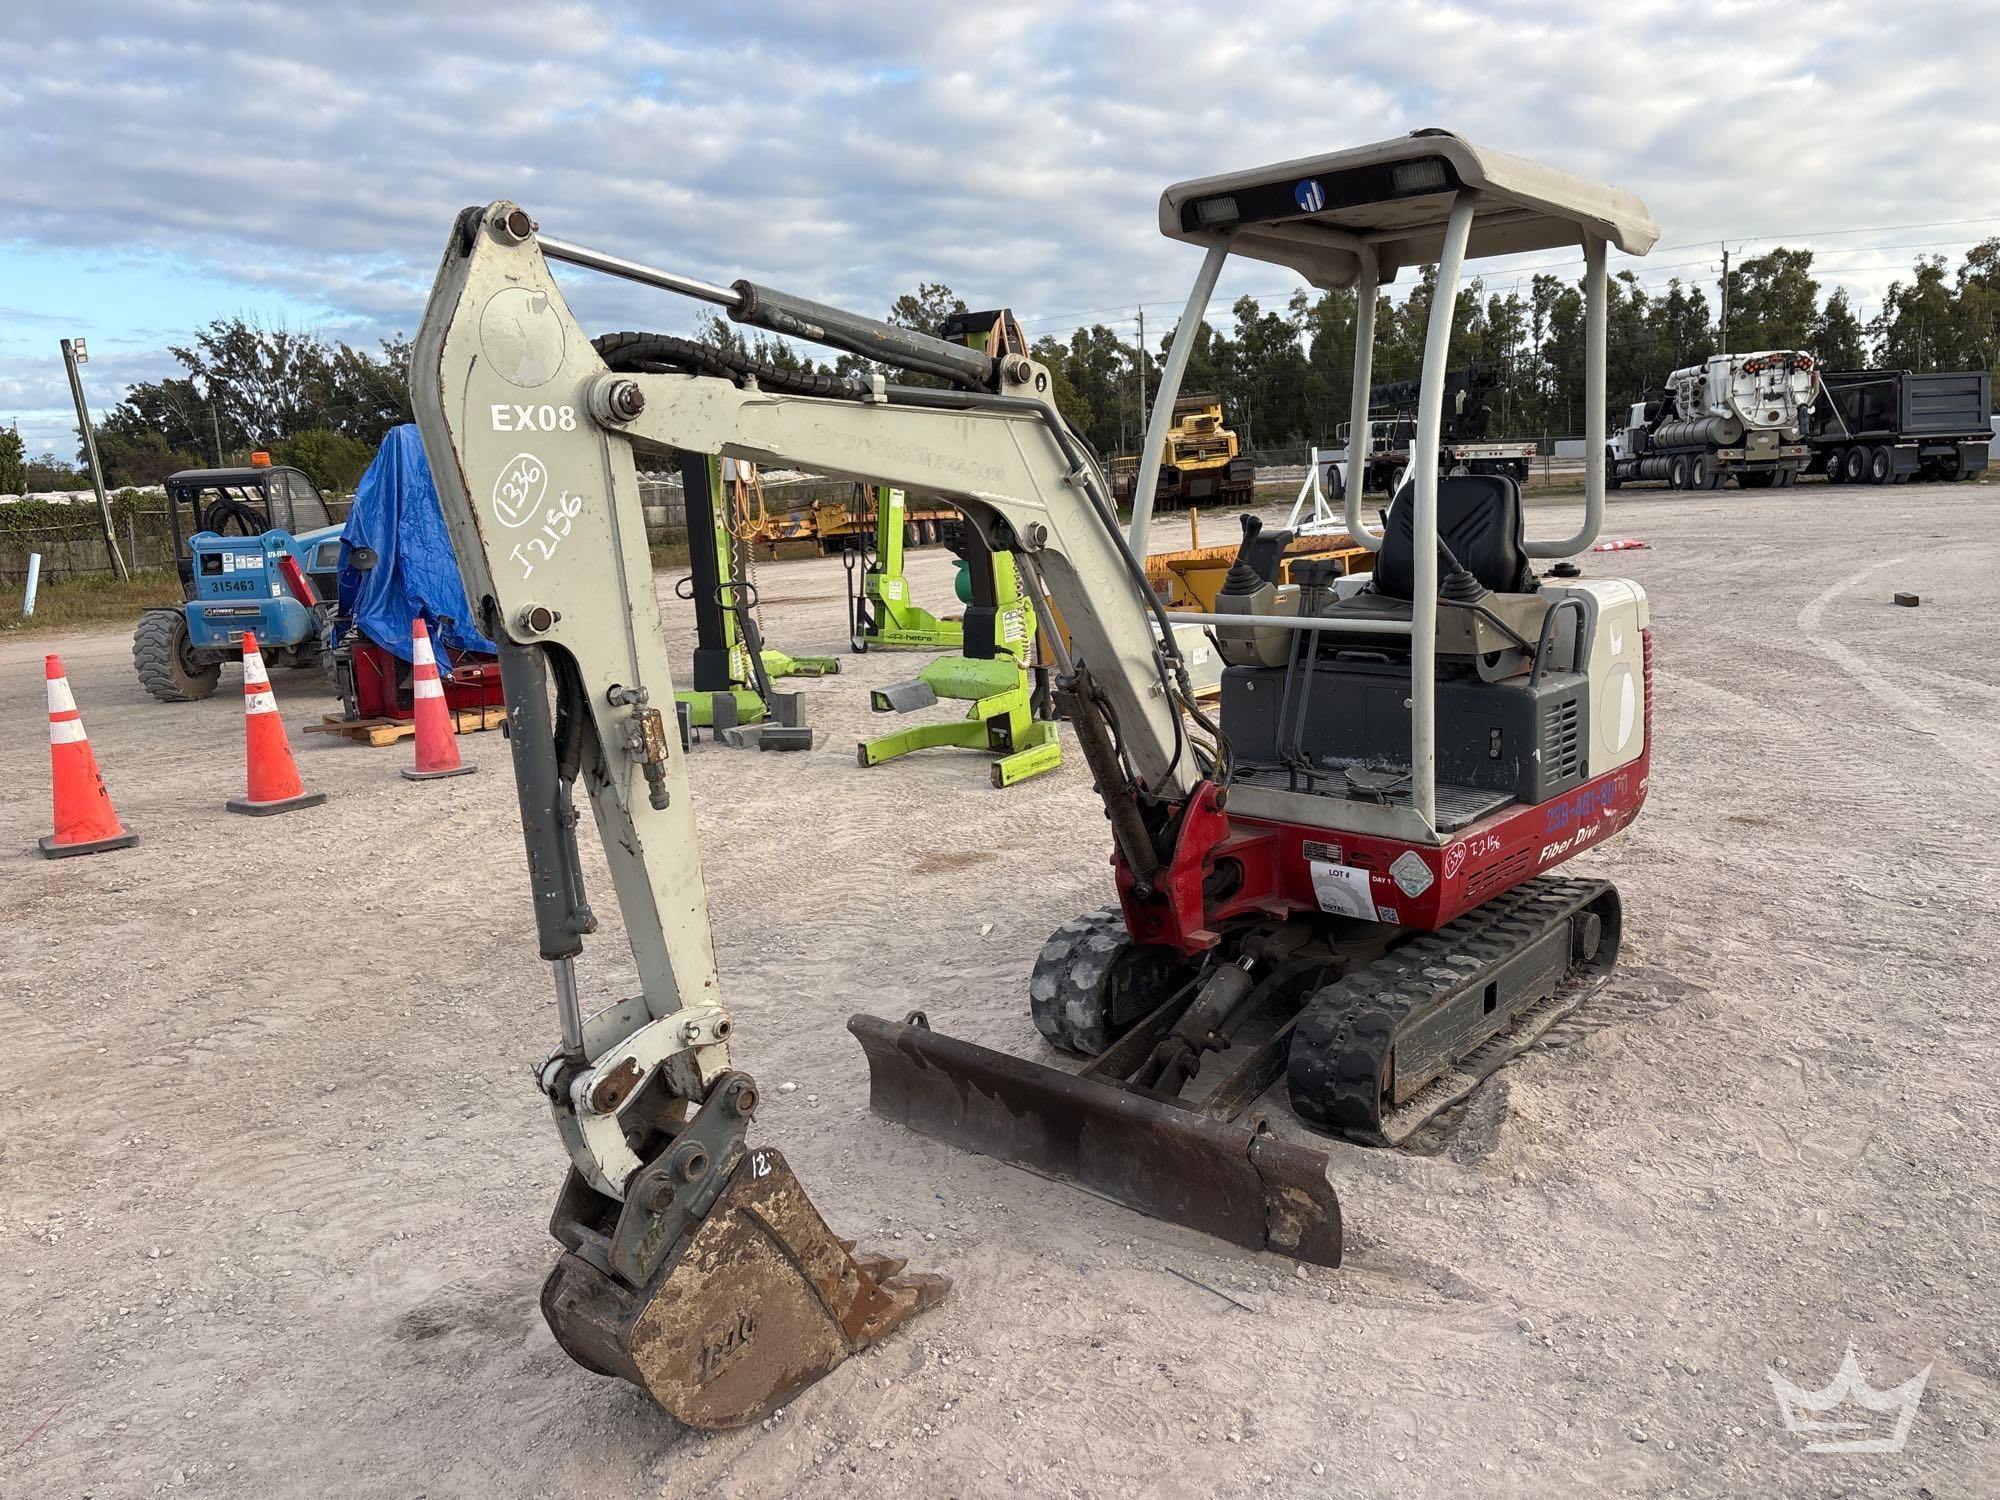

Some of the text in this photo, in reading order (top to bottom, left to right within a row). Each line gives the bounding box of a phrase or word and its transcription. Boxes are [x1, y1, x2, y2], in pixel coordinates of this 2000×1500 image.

[490, 404, 577, 432] EX08
[496, 460, 540, 518] 1336
[211, 580, 255, 592] 315463
[1538, 837, 1574, 865] Fiber
[1329, 869, 1350, 879] LOT #
[1372, 876, 1386, 884] DAY
